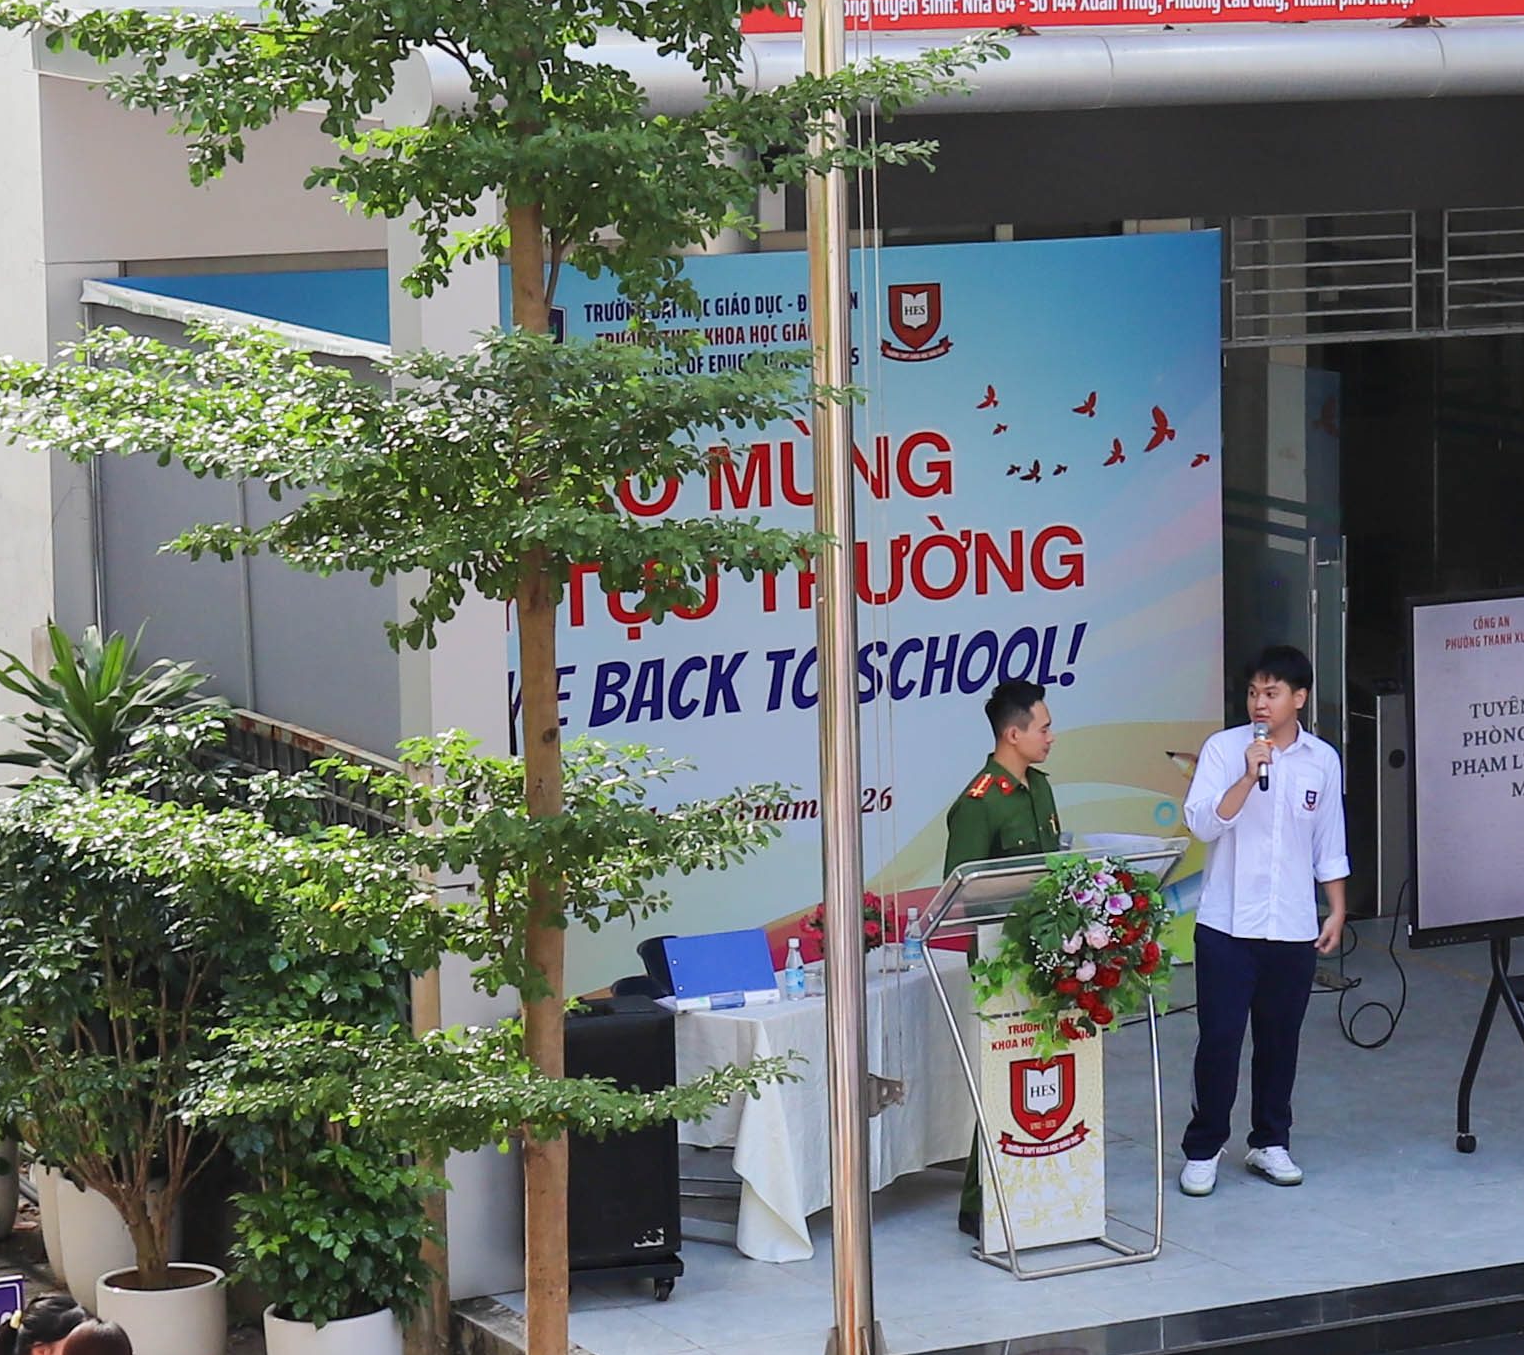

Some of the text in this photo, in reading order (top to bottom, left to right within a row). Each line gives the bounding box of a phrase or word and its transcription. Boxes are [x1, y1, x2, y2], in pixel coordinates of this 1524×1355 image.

[714, 291, 751, 319] GIÁO
[756, 295, 783, 322] DỤC
[904, 305, 926, 316] HES
[704, 326, 746, 346] KHOA
[749, 324, 780, 348] HỌC
[686, 352, 705, 374] OF
[1473, 615, 1511, 630] CÔNG AN
[1483, 632, 1512, 647] THANH
[588, 651, 749, 729] BACK
[856, 622, 1089, 706] SCHOOL!
[1451, 755, 1507, 778] PHẠM
[991, 1038, 1018, 1052] KHOA
[1030, 1084, 1057, 1098] HES
